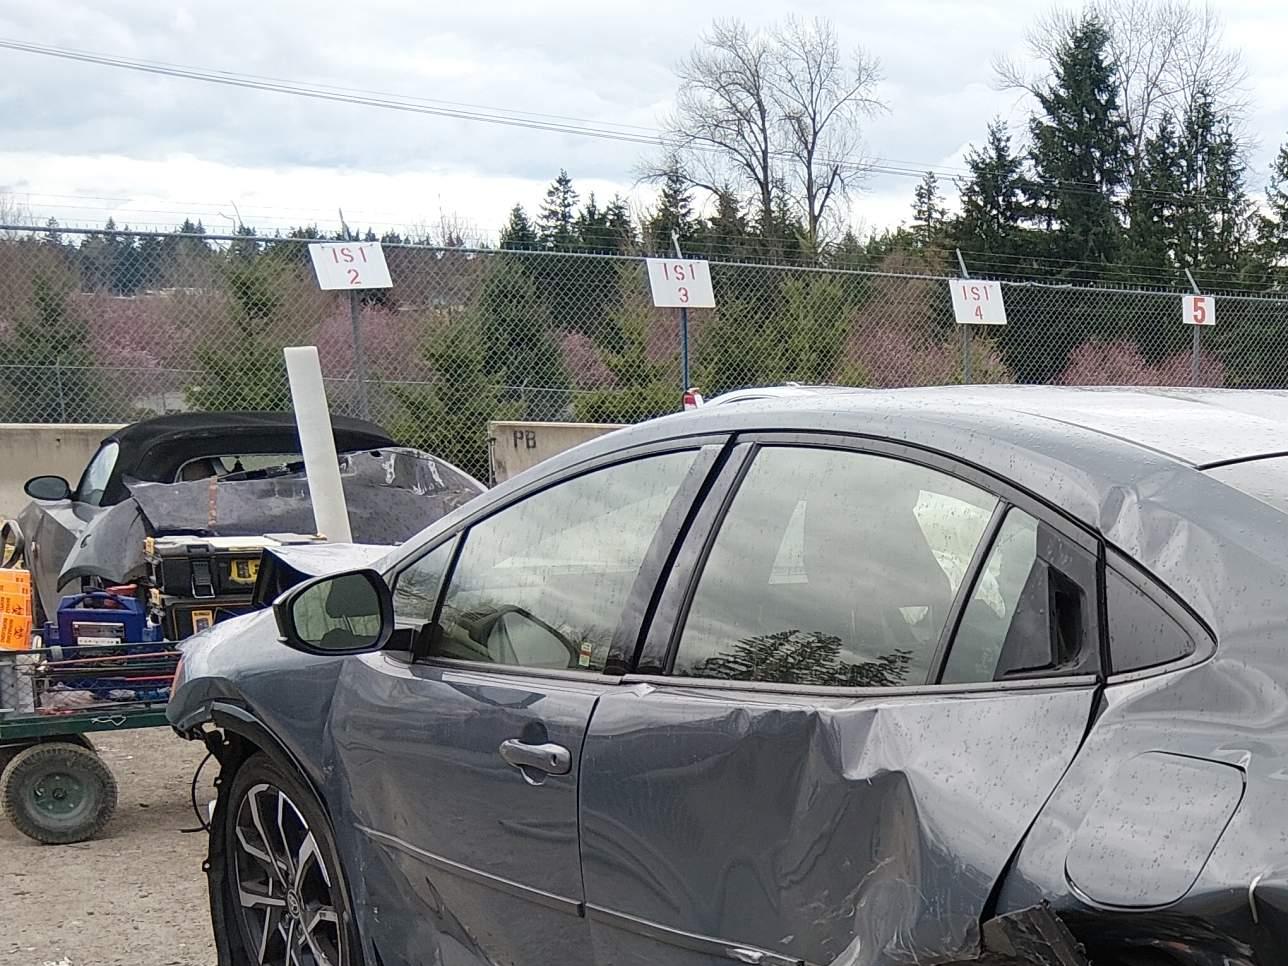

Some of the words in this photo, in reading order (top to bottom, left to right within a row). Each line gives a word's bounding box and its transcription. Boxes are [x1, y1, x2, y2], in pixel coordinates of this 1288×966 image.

[347, 268, 362, 285] 2
[678, 286, 689, 303] 3
[974, 305, 984, 320] 4
[1193, 297, 1206, 324] 5
[513, 430, 537, 449] PB
